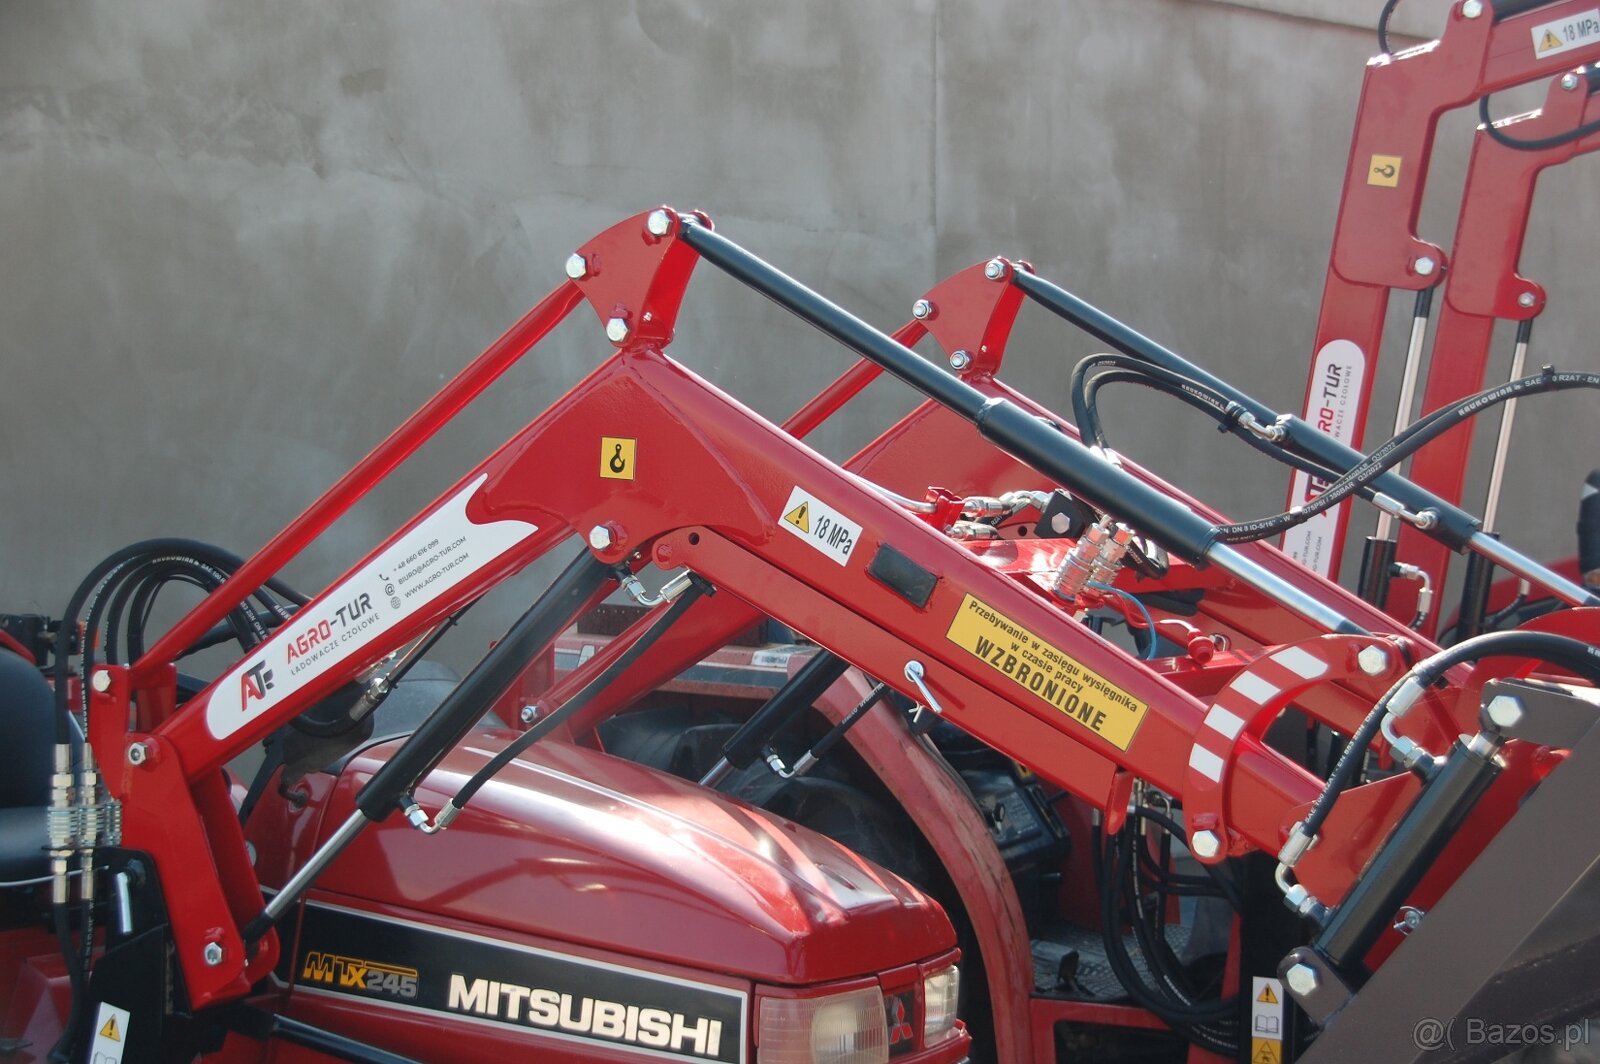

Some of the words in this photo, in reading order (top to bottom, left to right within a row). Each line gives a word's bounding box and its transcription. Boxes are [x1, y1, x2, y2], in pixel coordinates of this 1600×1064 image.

[1563, 24, 1575, 41] 18
[1576, 19, 1599, 38] MPa
[1318, 364, 1342, 432] RO-TUR
[1525, 378, 1541, 387] SAE
[1330, 482, 1355, 500] 350BAR
[1358, 463, 1382, 481] Q3/2022
[398, 561, 406, 569] 48
[406, 554, 417, 564] 660
[417, 546, 427, 556] 616
[814, 515, 830, 539] 18
[827, 523, 852, 556] MPa
[398, 536, 466, 585] BIURO@AGRO-TUR.COM
[405, 552, 469, 598] WWW.AGRO-TUR.COM
[288, 592, 372, 664] AGRO-TUR
[969, 600, 1029, 644] Przebywanie
[1031, 640, 1040, 650] w
[1042, 647, 1080, 676] zasięgu
[1082, 672, 1137, 712] wysięgnika
[1010, 642, 1019, 652] w
[1022, 650, 1053, 673] czasie
[1054, 670, 1084, 693] pracy
[975, 635, 1107, 731] WZBRONIONE
[448, 974, 722, 1056] MITSUBISHI
